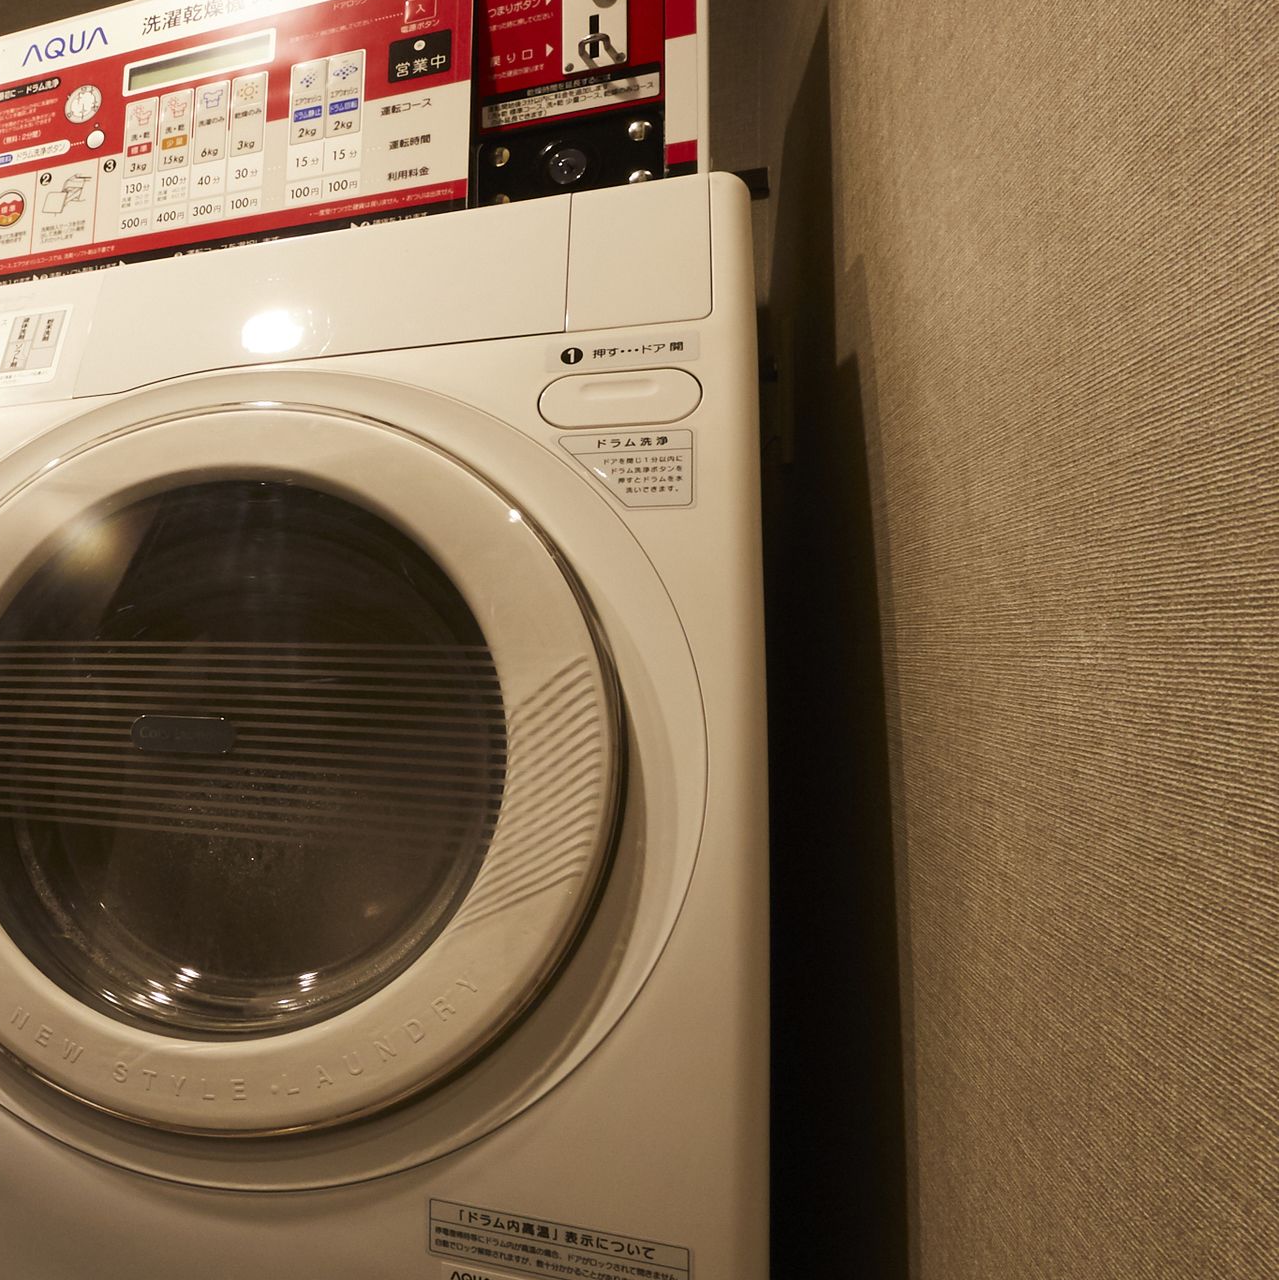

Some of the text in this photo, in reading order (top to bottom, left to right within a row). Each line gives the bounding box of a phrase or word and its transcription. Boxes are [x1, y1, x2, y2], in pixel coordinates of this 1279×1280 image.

[415, 3, 427, 15] 入
[22, 26, 109, 67] AQUA
[395, 53, 447, 78] 営業中
[380, 97, 432, 117] 運転コース
[297, 127, 317, 138] 2kg
[332, 119, 353, 131] 2kg
[236, 140, 255, 150] 3kg
[388, 134, 431, 150] 運転時間
[200, 147, 219, 158] 6kg
[129, 162, 147, 173] 3kg
[387, 165, 430, 181] 利用料金
[597, 435, 669, 449] ドラム洗浄
[10, 1006, 84, 1064] NEW
[112, 1061, 247, 1101] STYLE
[281, 978, 478, 1096] LAUNDRY
[458, 1209, 656, 1260] 「ドラム内高温」表示について
